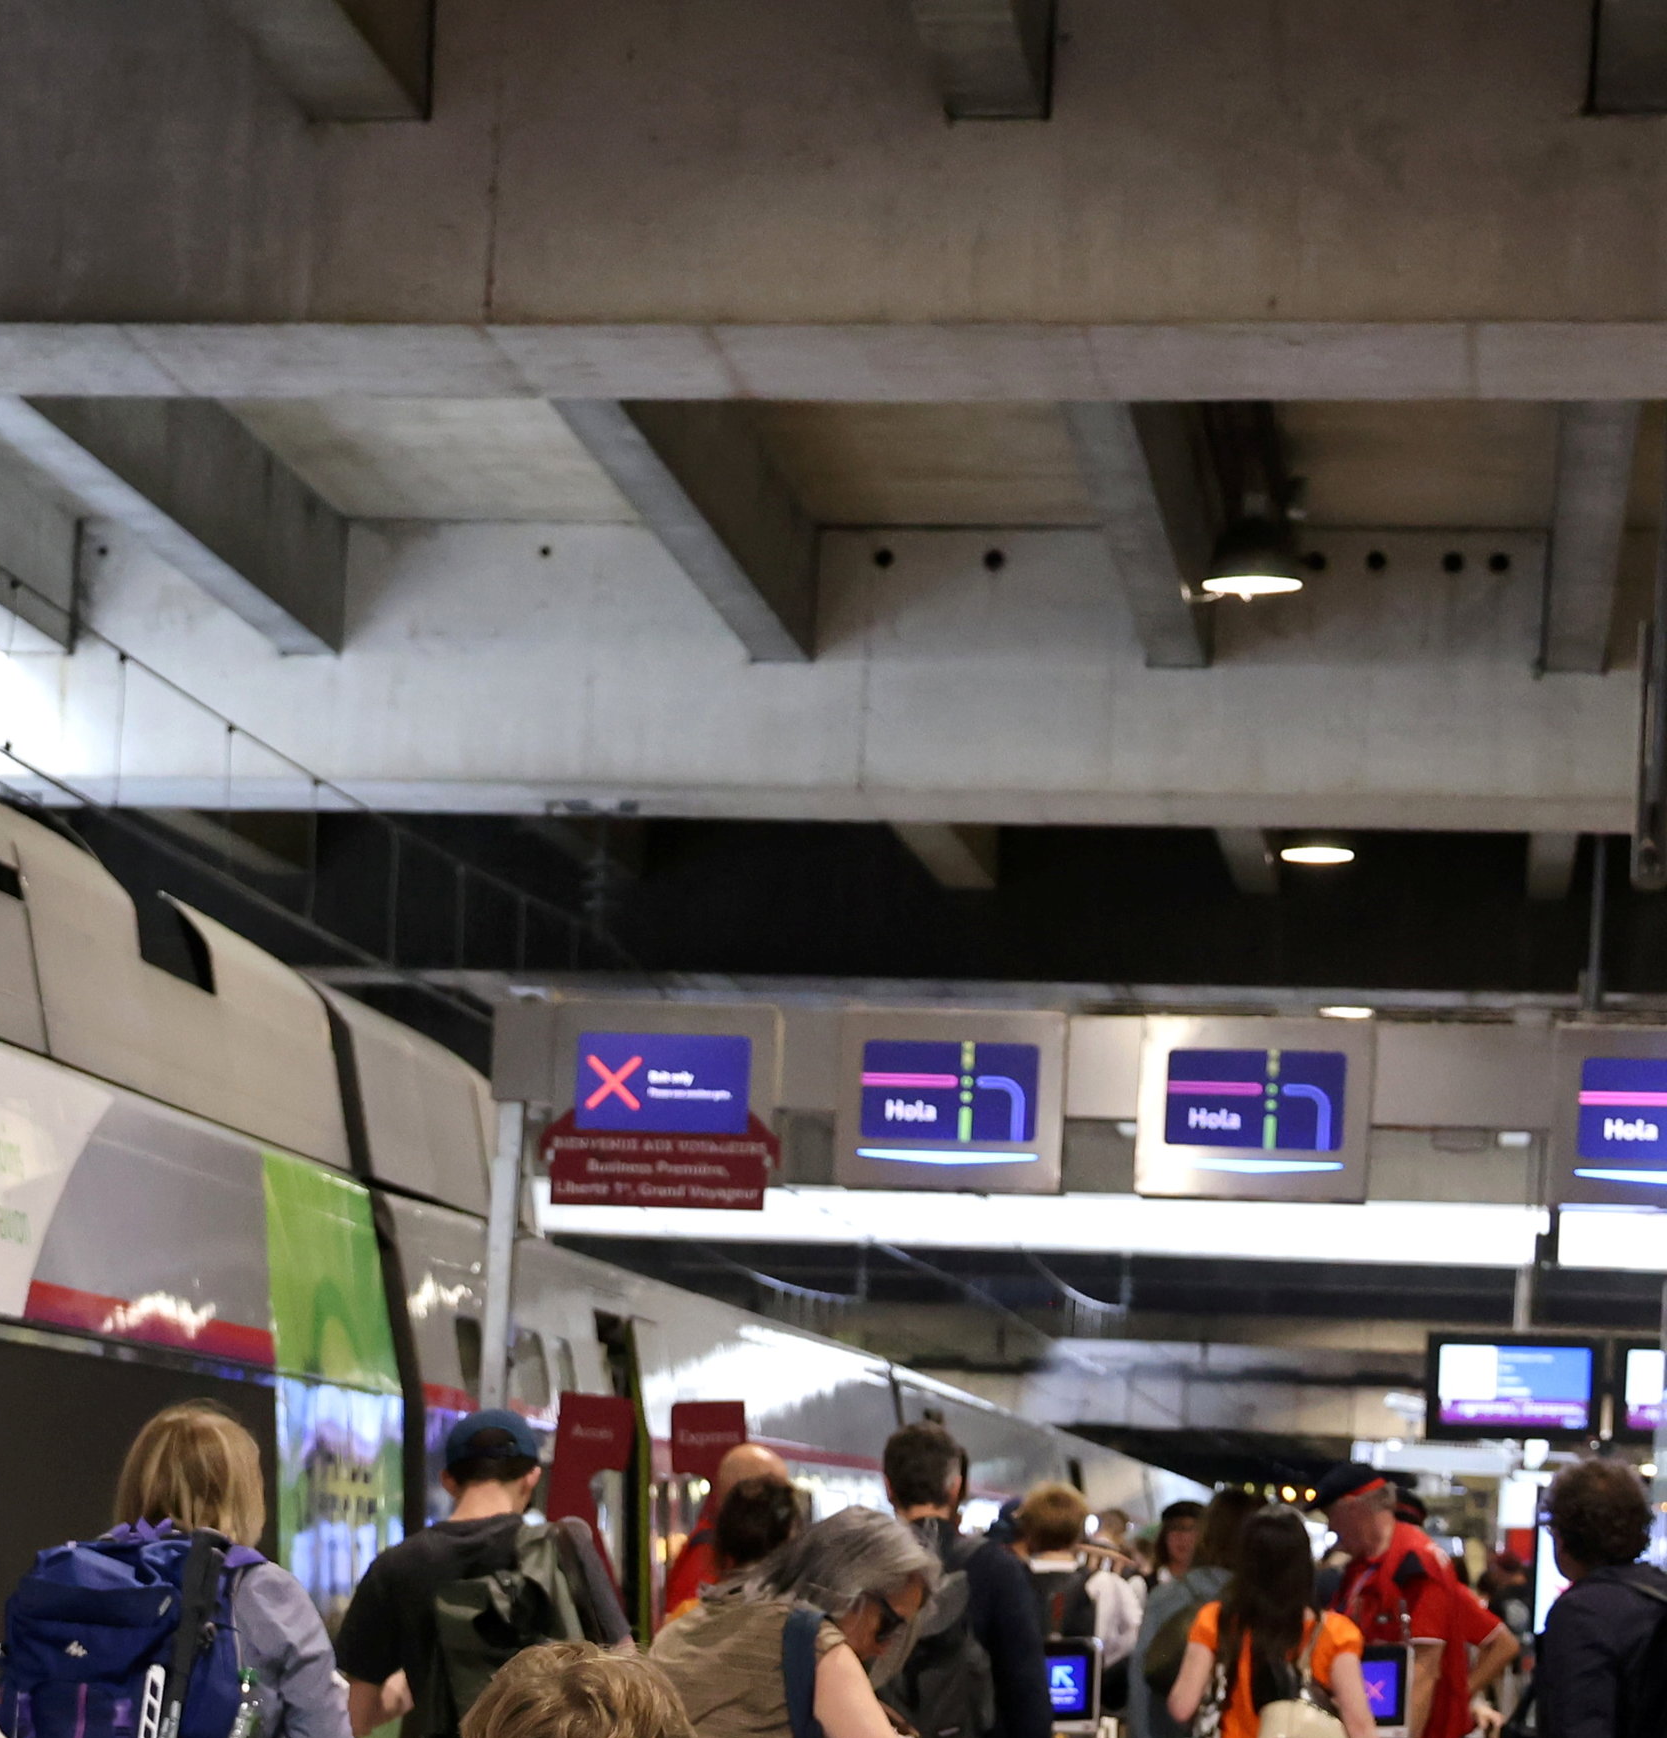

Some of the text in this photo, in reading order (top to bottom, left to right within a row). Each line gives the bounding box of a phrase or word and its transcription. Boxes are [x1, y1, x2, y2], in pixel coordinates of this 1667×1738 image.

[884, 1098, 938, 1122] Hola
[1188, 1107, 1242, 1130] Hola
[1603, 1117, 1659, 1141] Hola
[586, 1158, 652, 1174] Business
[638, 1183, 686, 1198] Grand
[689, 1184, 758, 1203] Voyageur
